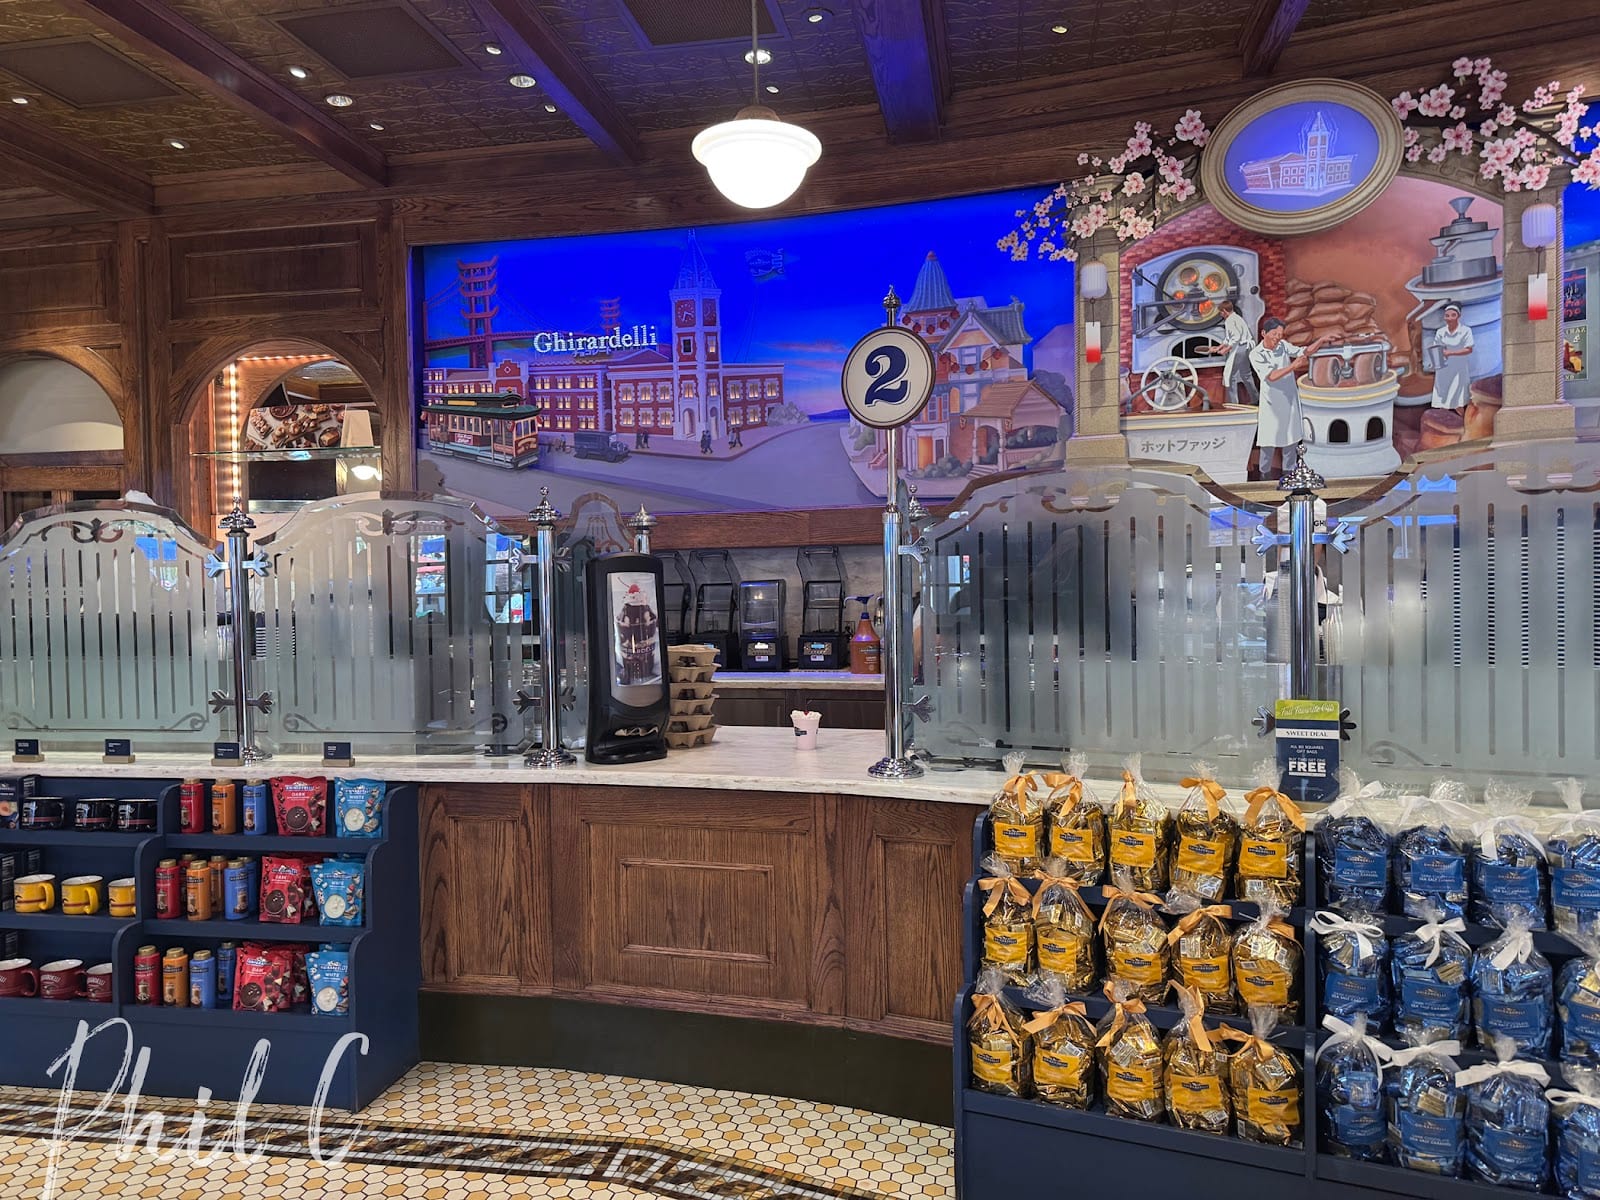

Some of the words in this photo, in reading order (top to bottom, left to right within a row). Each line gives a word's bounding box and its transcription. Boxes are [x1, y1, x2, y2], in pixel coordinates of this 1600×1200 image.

[533, 324, 658, 353] Ghirardelli
[865, 345, 911, 407] 2
[1140, 436, 1226, 453] ホットファッジ
[1288, 761, 1327, 773] FREE
